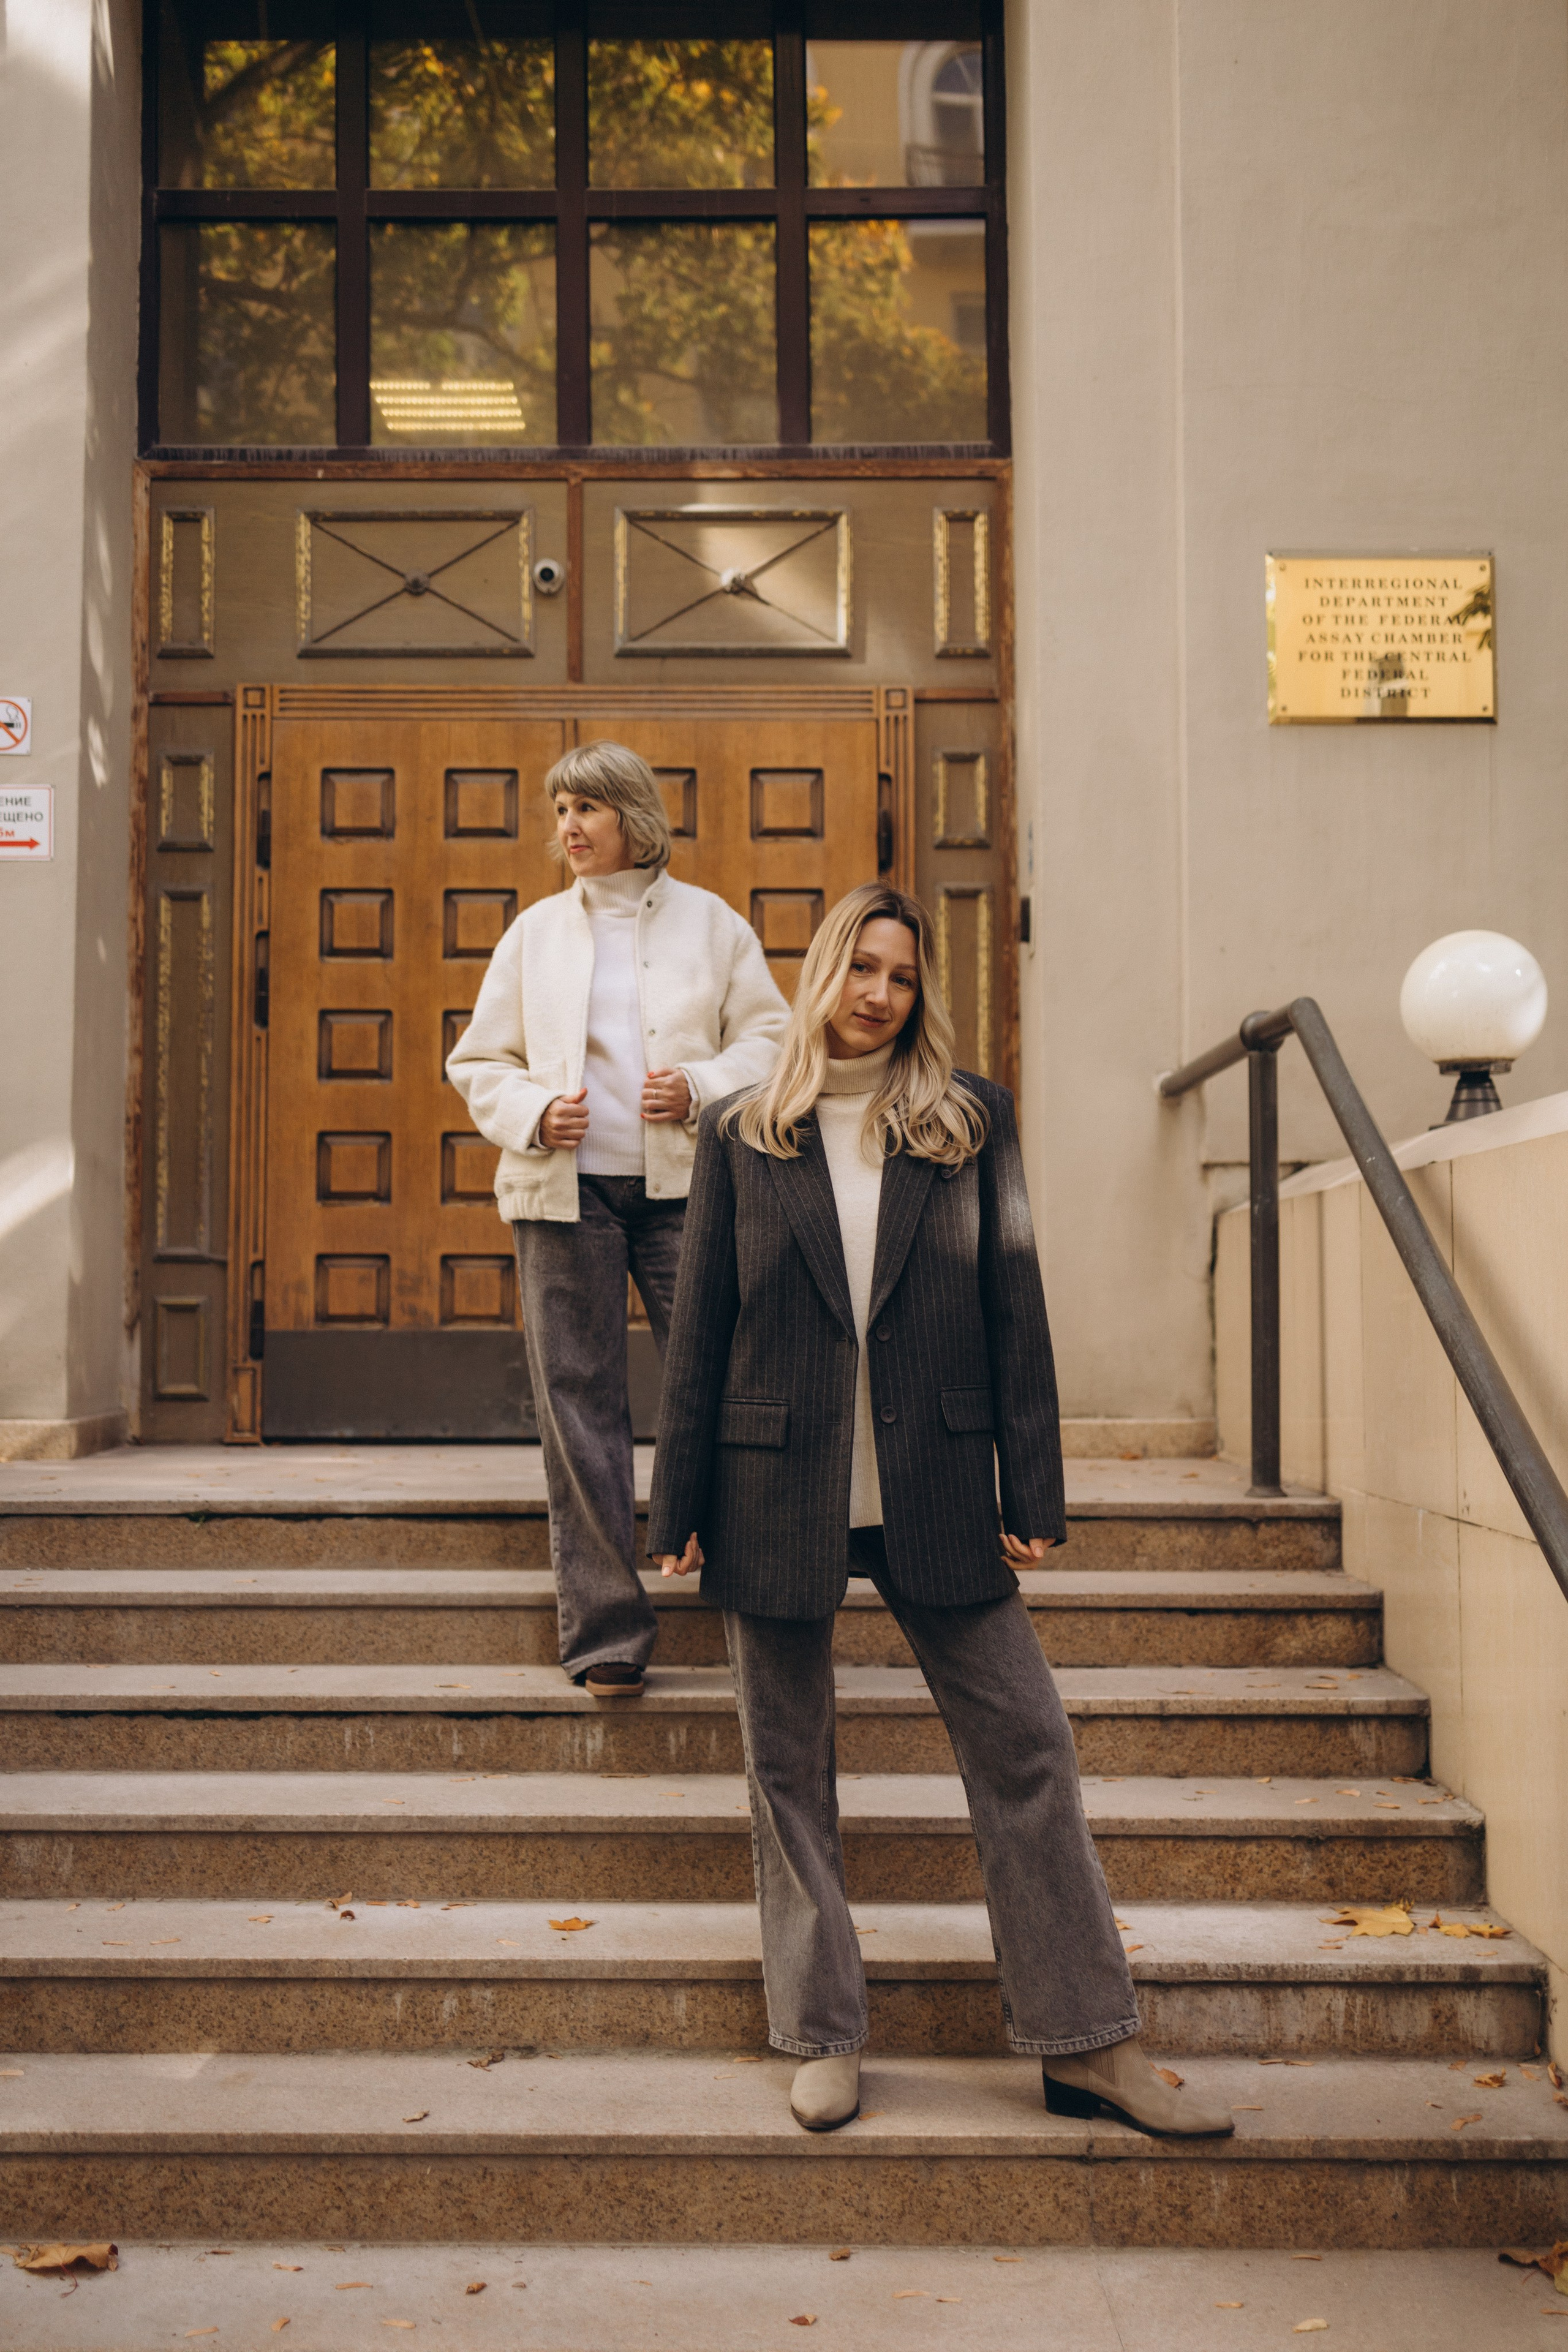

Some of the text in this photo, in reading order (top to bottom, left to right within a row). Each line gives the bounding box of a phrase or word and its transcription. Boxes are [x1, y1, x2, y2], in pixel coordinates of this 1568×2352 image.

[1305, 578, 1463, 590] INTERREGIONAL
[1320, 596, 1449, 608] DEPARTMENT
[1302, 614, 1464, 626] OF THE FEDERAL
[1306, 633, 1463, 644] ASSAY CHAMBER
[1298, 651, 1471, 663] FOR THE CENTRAL
[1342, 669, 1428, 680] FEDERAL
[1341, 687, 1431, 699] DISTRICT
[0, 812, 43, 823] ЩЕНО
